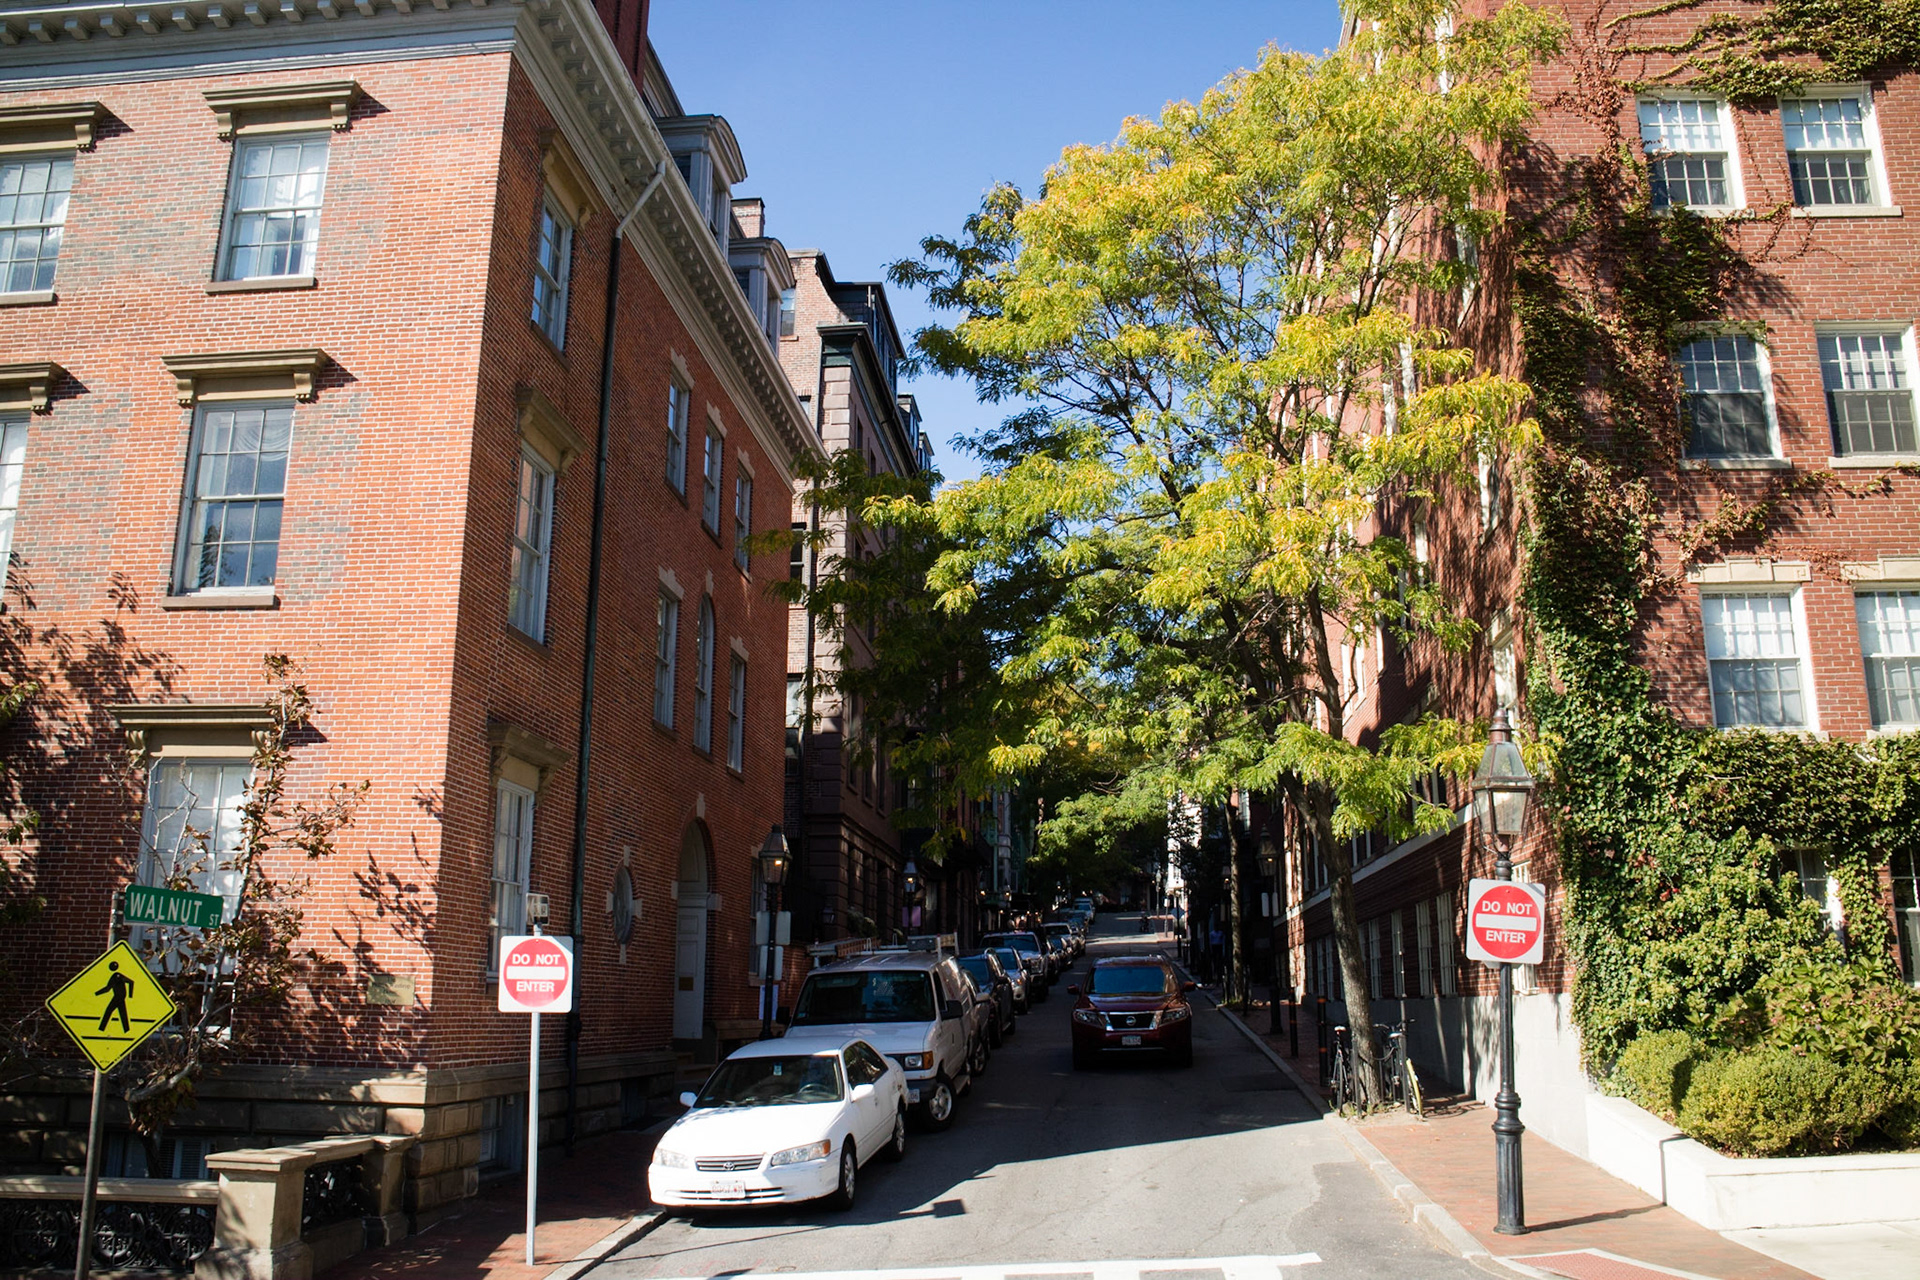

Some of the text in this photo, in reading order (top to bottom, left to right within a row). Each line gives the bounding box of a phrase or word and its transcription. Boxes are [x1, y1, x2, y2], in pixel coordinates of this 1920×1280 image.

[130, 891, 219, 926] WALNUT ST
[1482, 900, 1533, 915] DO NOT
[1485, 930, 1526, 944] ENTER
[512, 953, 561, 965] DO NOT
[516, 981, 555, 992] ENTER
